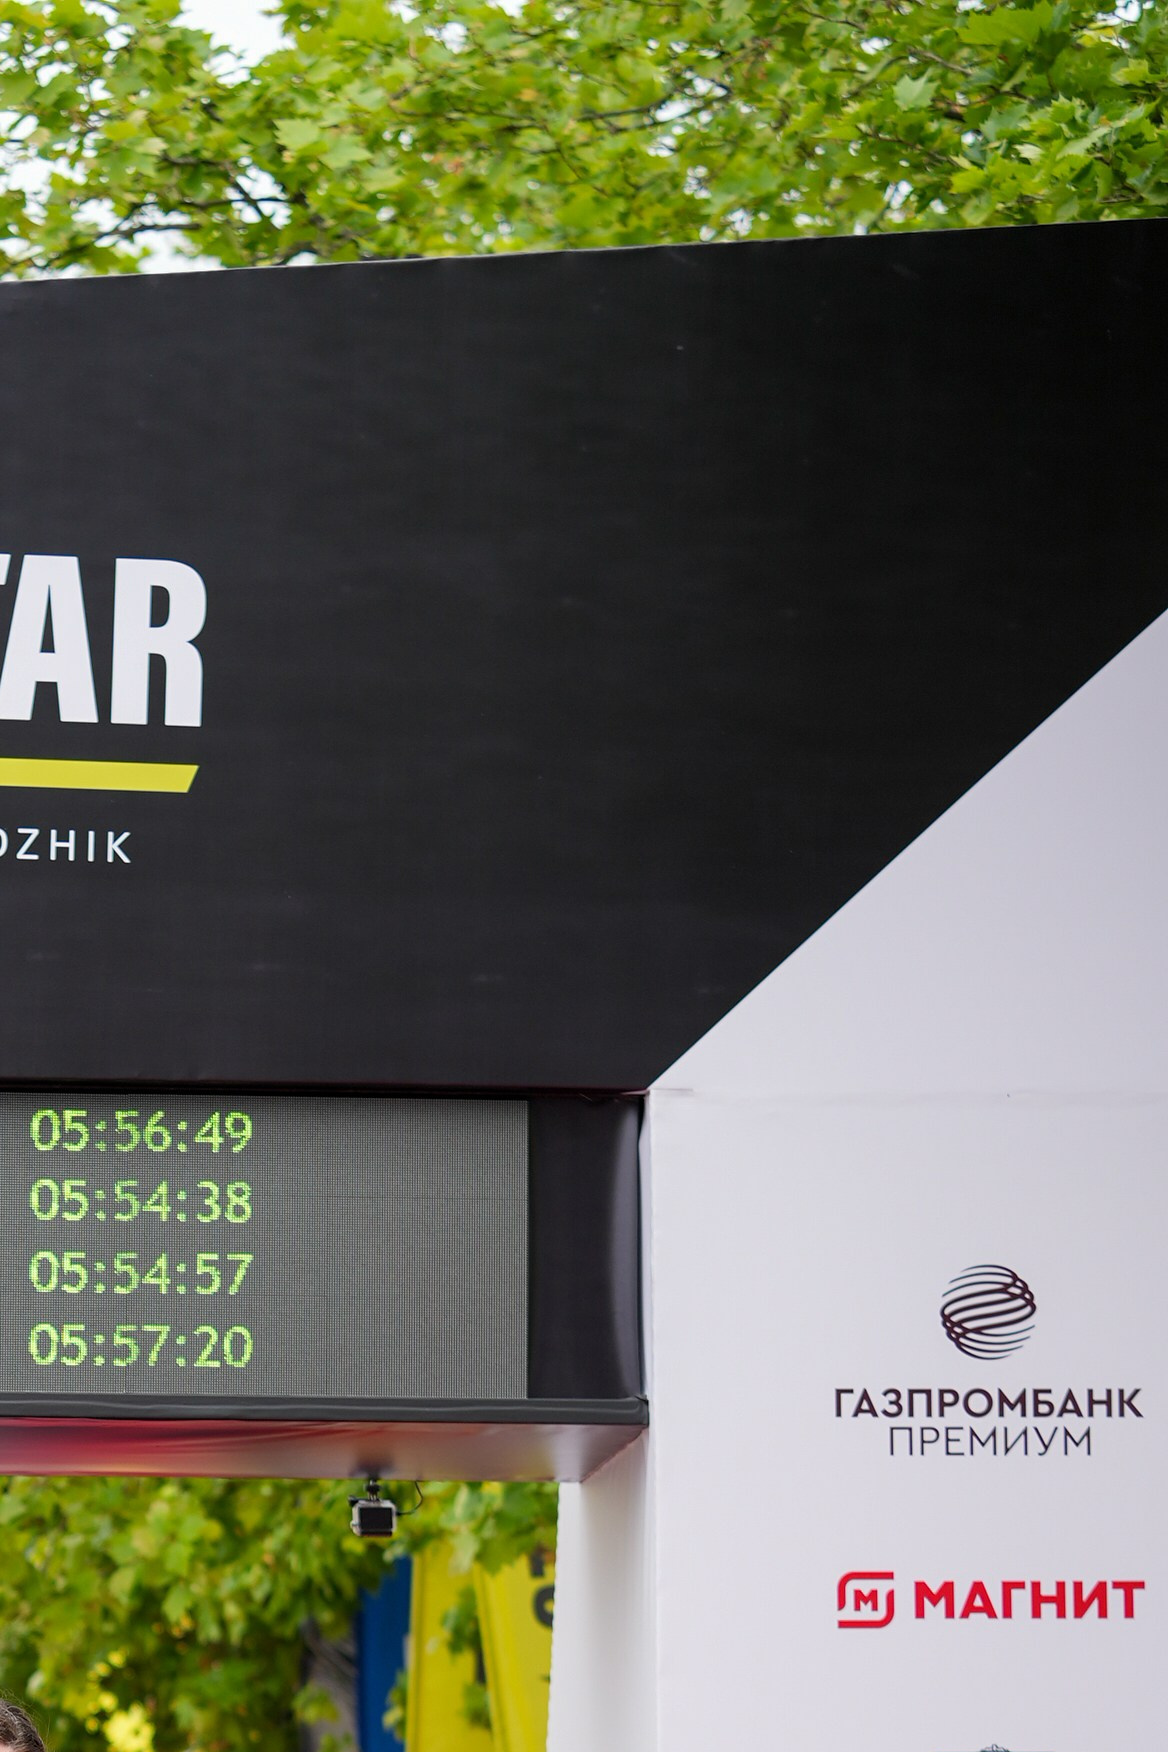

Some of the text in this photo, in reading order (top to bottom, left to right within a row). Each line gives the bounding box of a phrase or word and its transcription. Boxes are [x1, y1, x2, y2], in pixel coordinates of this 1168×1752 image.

[29, 1109, 253, 1153] 05:56:49
[29, 1178, 253, 1223] 05:54:38
[29, 1251, 254, 1295] 05:54:57
[28, 1323, 253, 1368] 05:57:20
[834, 1388, 1144, 1418] ГАЗПРОМБАНК
[889, 1426, 1092, 1457] ПРЕМИУМ
[914, 1580, 1146, 1619] МАГНИТ
